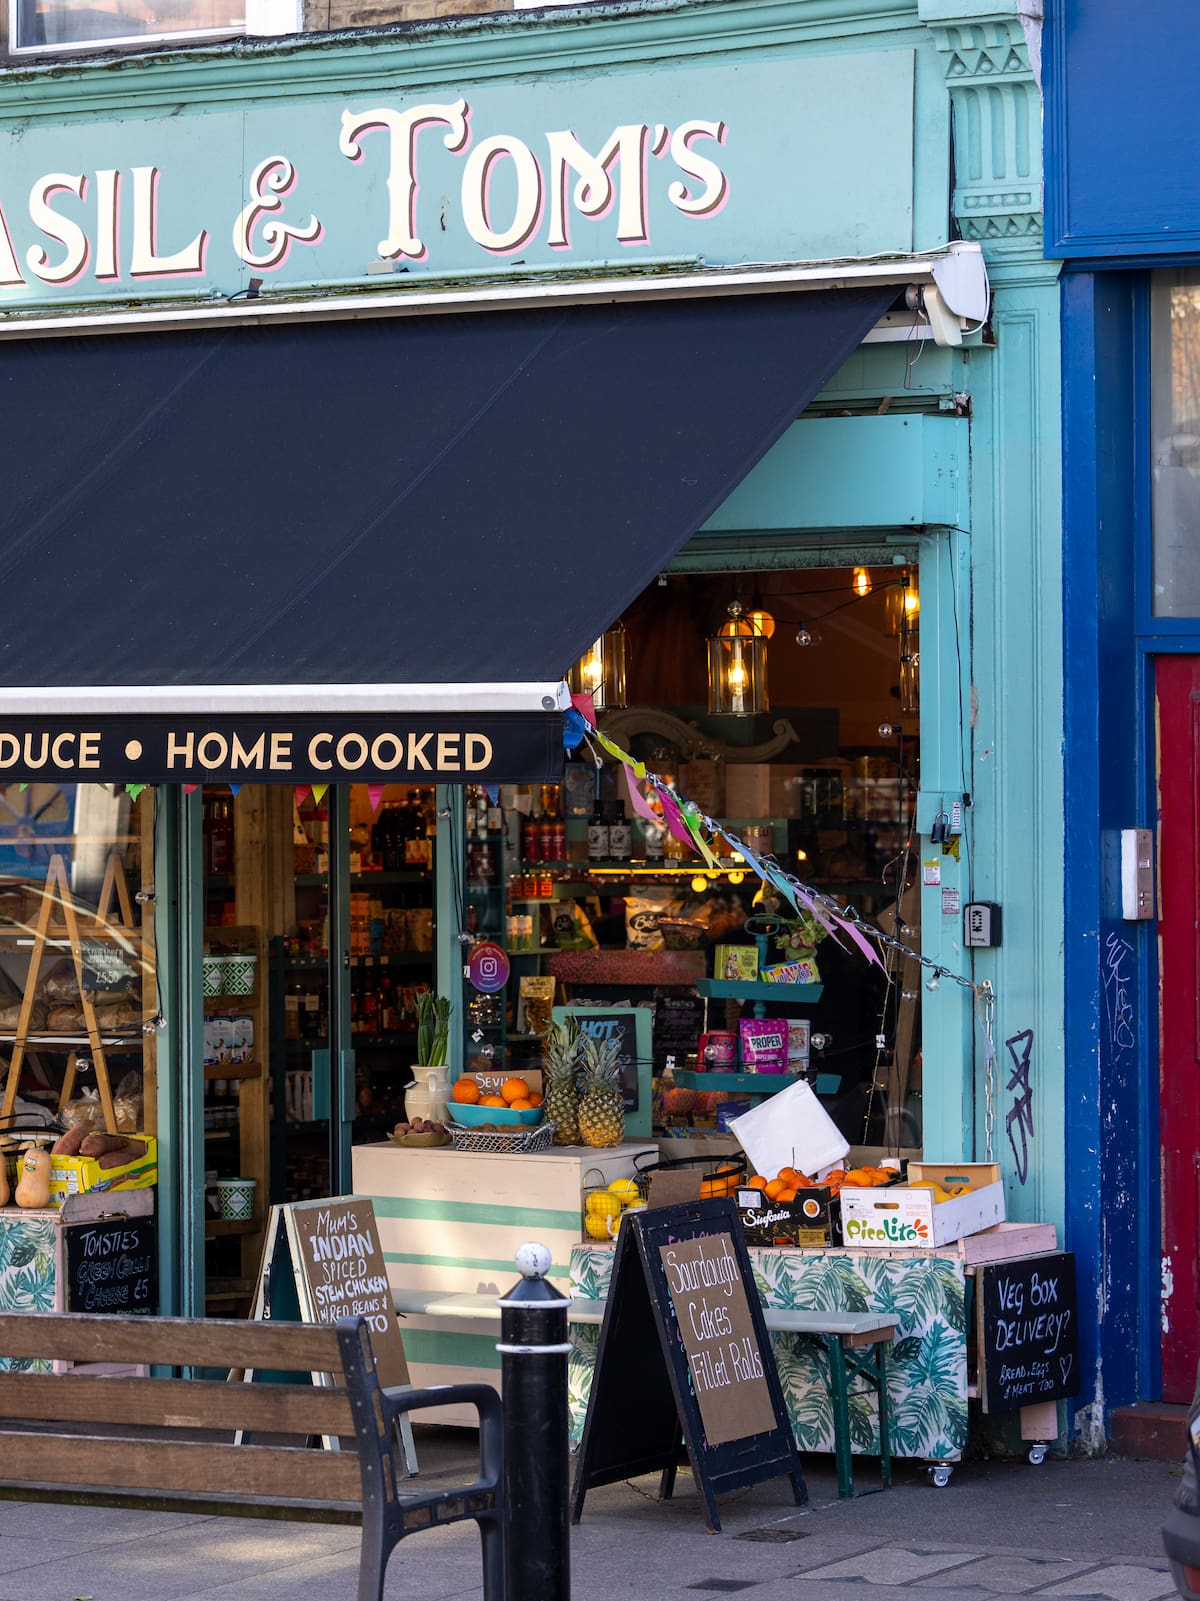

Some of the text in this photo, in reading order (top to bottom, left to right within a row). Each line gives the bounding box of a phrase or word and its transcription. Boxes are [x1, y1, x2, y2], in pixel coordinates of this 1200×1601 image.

[233, 155, 325, 272] &
[166, 731, 294, 770] HOME
[308, 732, 493, 771] COOKED
[581, 1021, 619, 1040] HOT
[750, 1035, 782, 1049] PROPER
[80, 1230, 139, 1257] TOASTIES
[309, 1228, 375, 1263] INDIAN
[322, 1258, 367, 1285] SPICED
[666, 1238, 739, 1297] Sourdough
[84, 1278, 149, 1310] CHEESE £5
[315, 1275, 388, 1305] STEW CHICKEN
[998, 1272, 1058, 1316] VEG BOX
[352, 1298, 379, 1316] BEANS
[688, 1297, 732, 1341] Cakes
[996, 1310, 1071, 1354] DELIVERY?
[691, 1337, 764, 1393] Filled Rolls
[1012, 1381, 1036, 1399] MEAT
[1039, 1379, 1054, 1391] TOO
